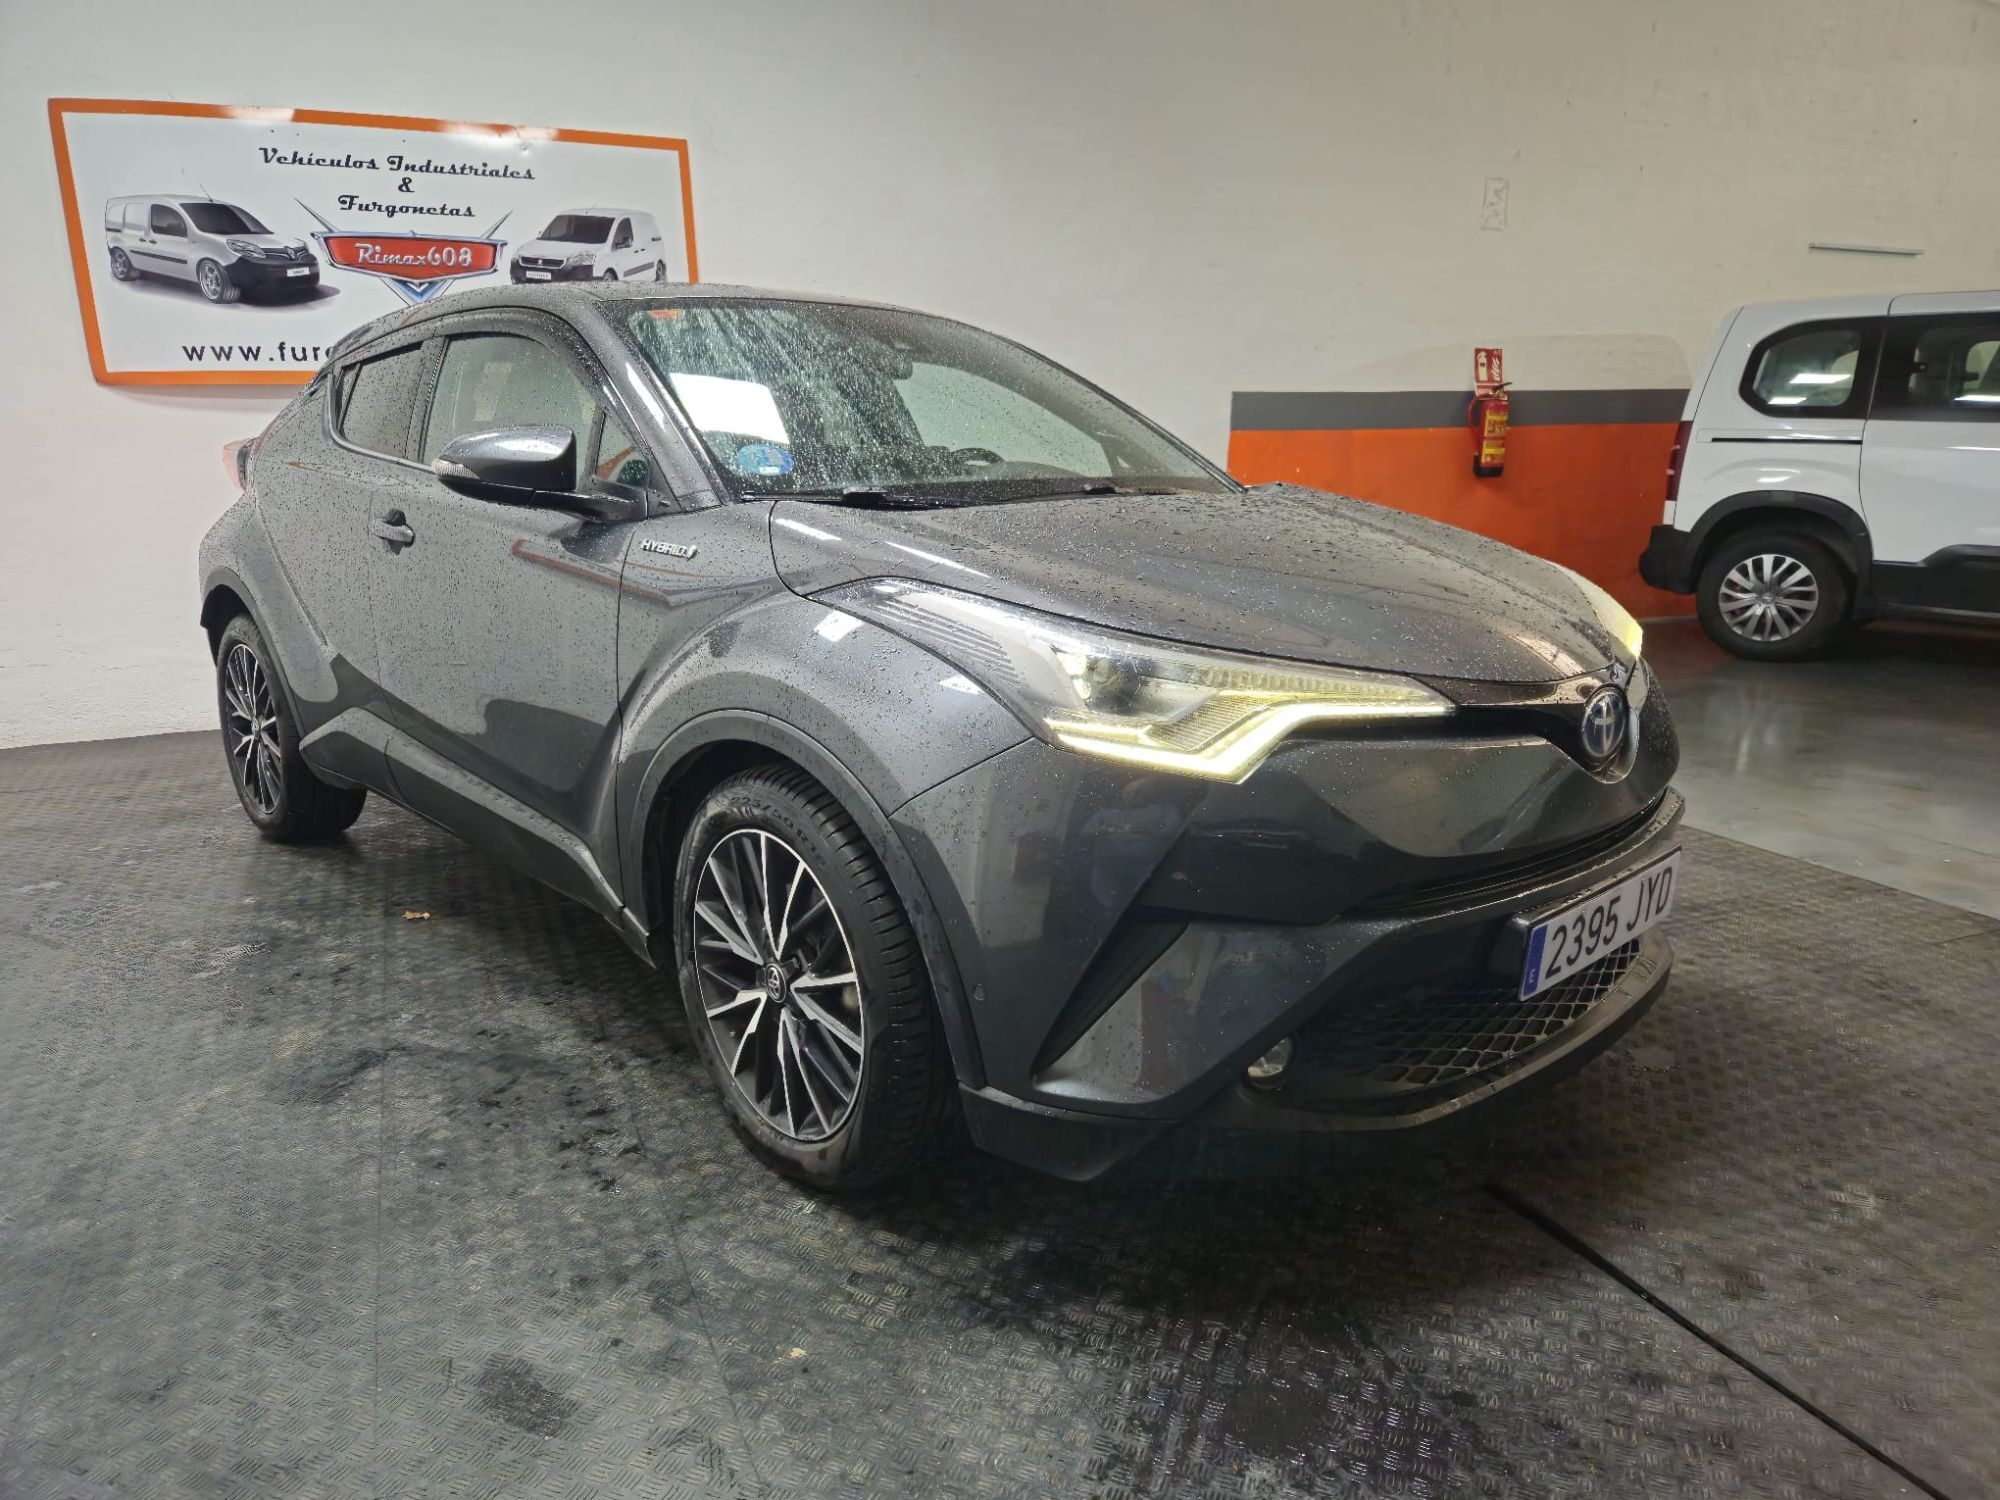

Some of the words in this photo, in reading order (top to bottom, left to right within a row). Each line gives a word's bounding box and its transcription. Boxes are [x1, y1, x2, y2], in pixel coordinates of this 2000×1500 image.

[387, 155, 536, 180] Industriales
[398, 177, 415, 193] &
[338, 195, 476, 218] Furgonetas
[355, 243, 473, 267] Rimax608
[641, 539, 688, 557] HYBRID
[1545, 895, 1621, 979] 2395
[1626, 866, 1673, 932] JYD
